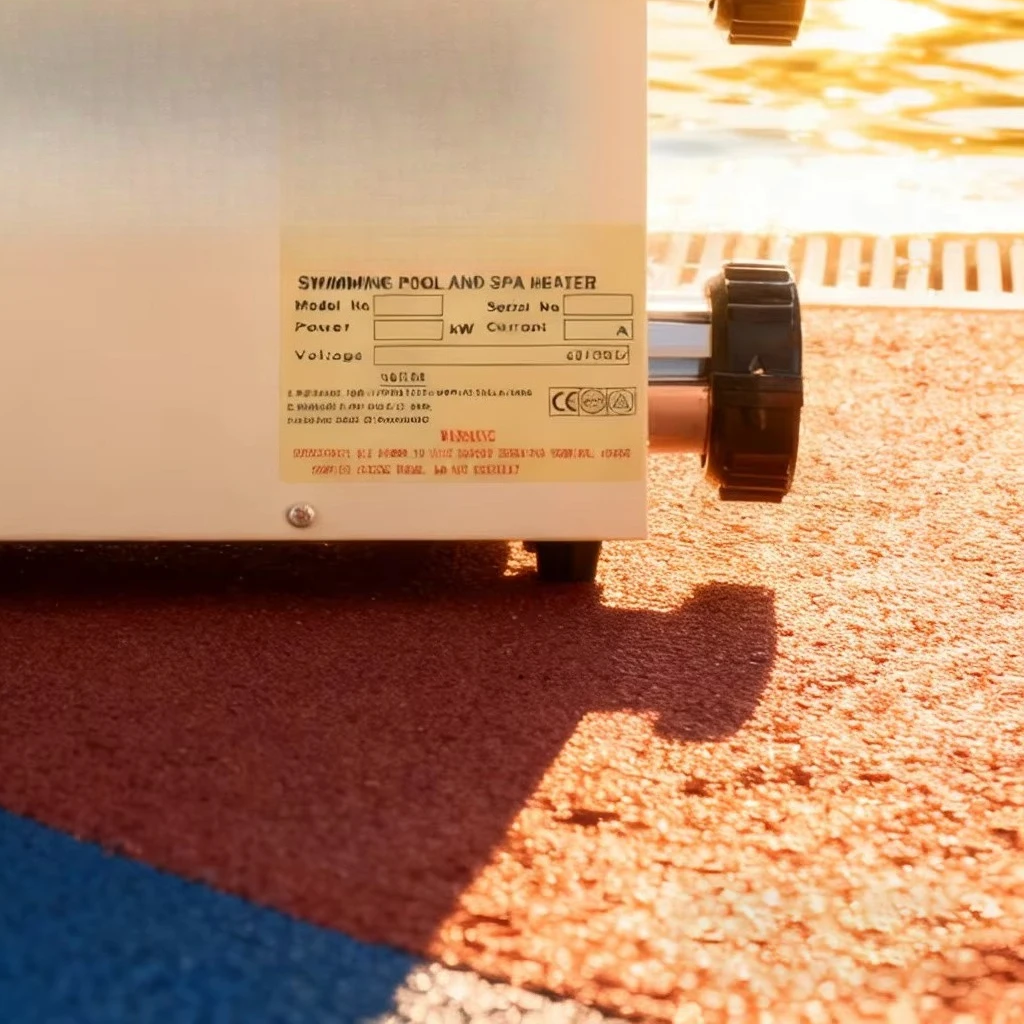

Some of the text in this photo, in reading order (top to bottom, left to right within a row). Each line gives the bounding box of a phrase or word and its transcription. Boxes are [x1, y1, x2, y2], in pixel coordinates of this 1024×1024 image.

[398, 275, 444, 290] POOL
[448, 275, 485, 290] AND
[489, 275, 525, 290] SPA
[530, 275, 597, 290] HEATER
[450, 323, 474, 334] kW
[616, 326, 629, 336] A
